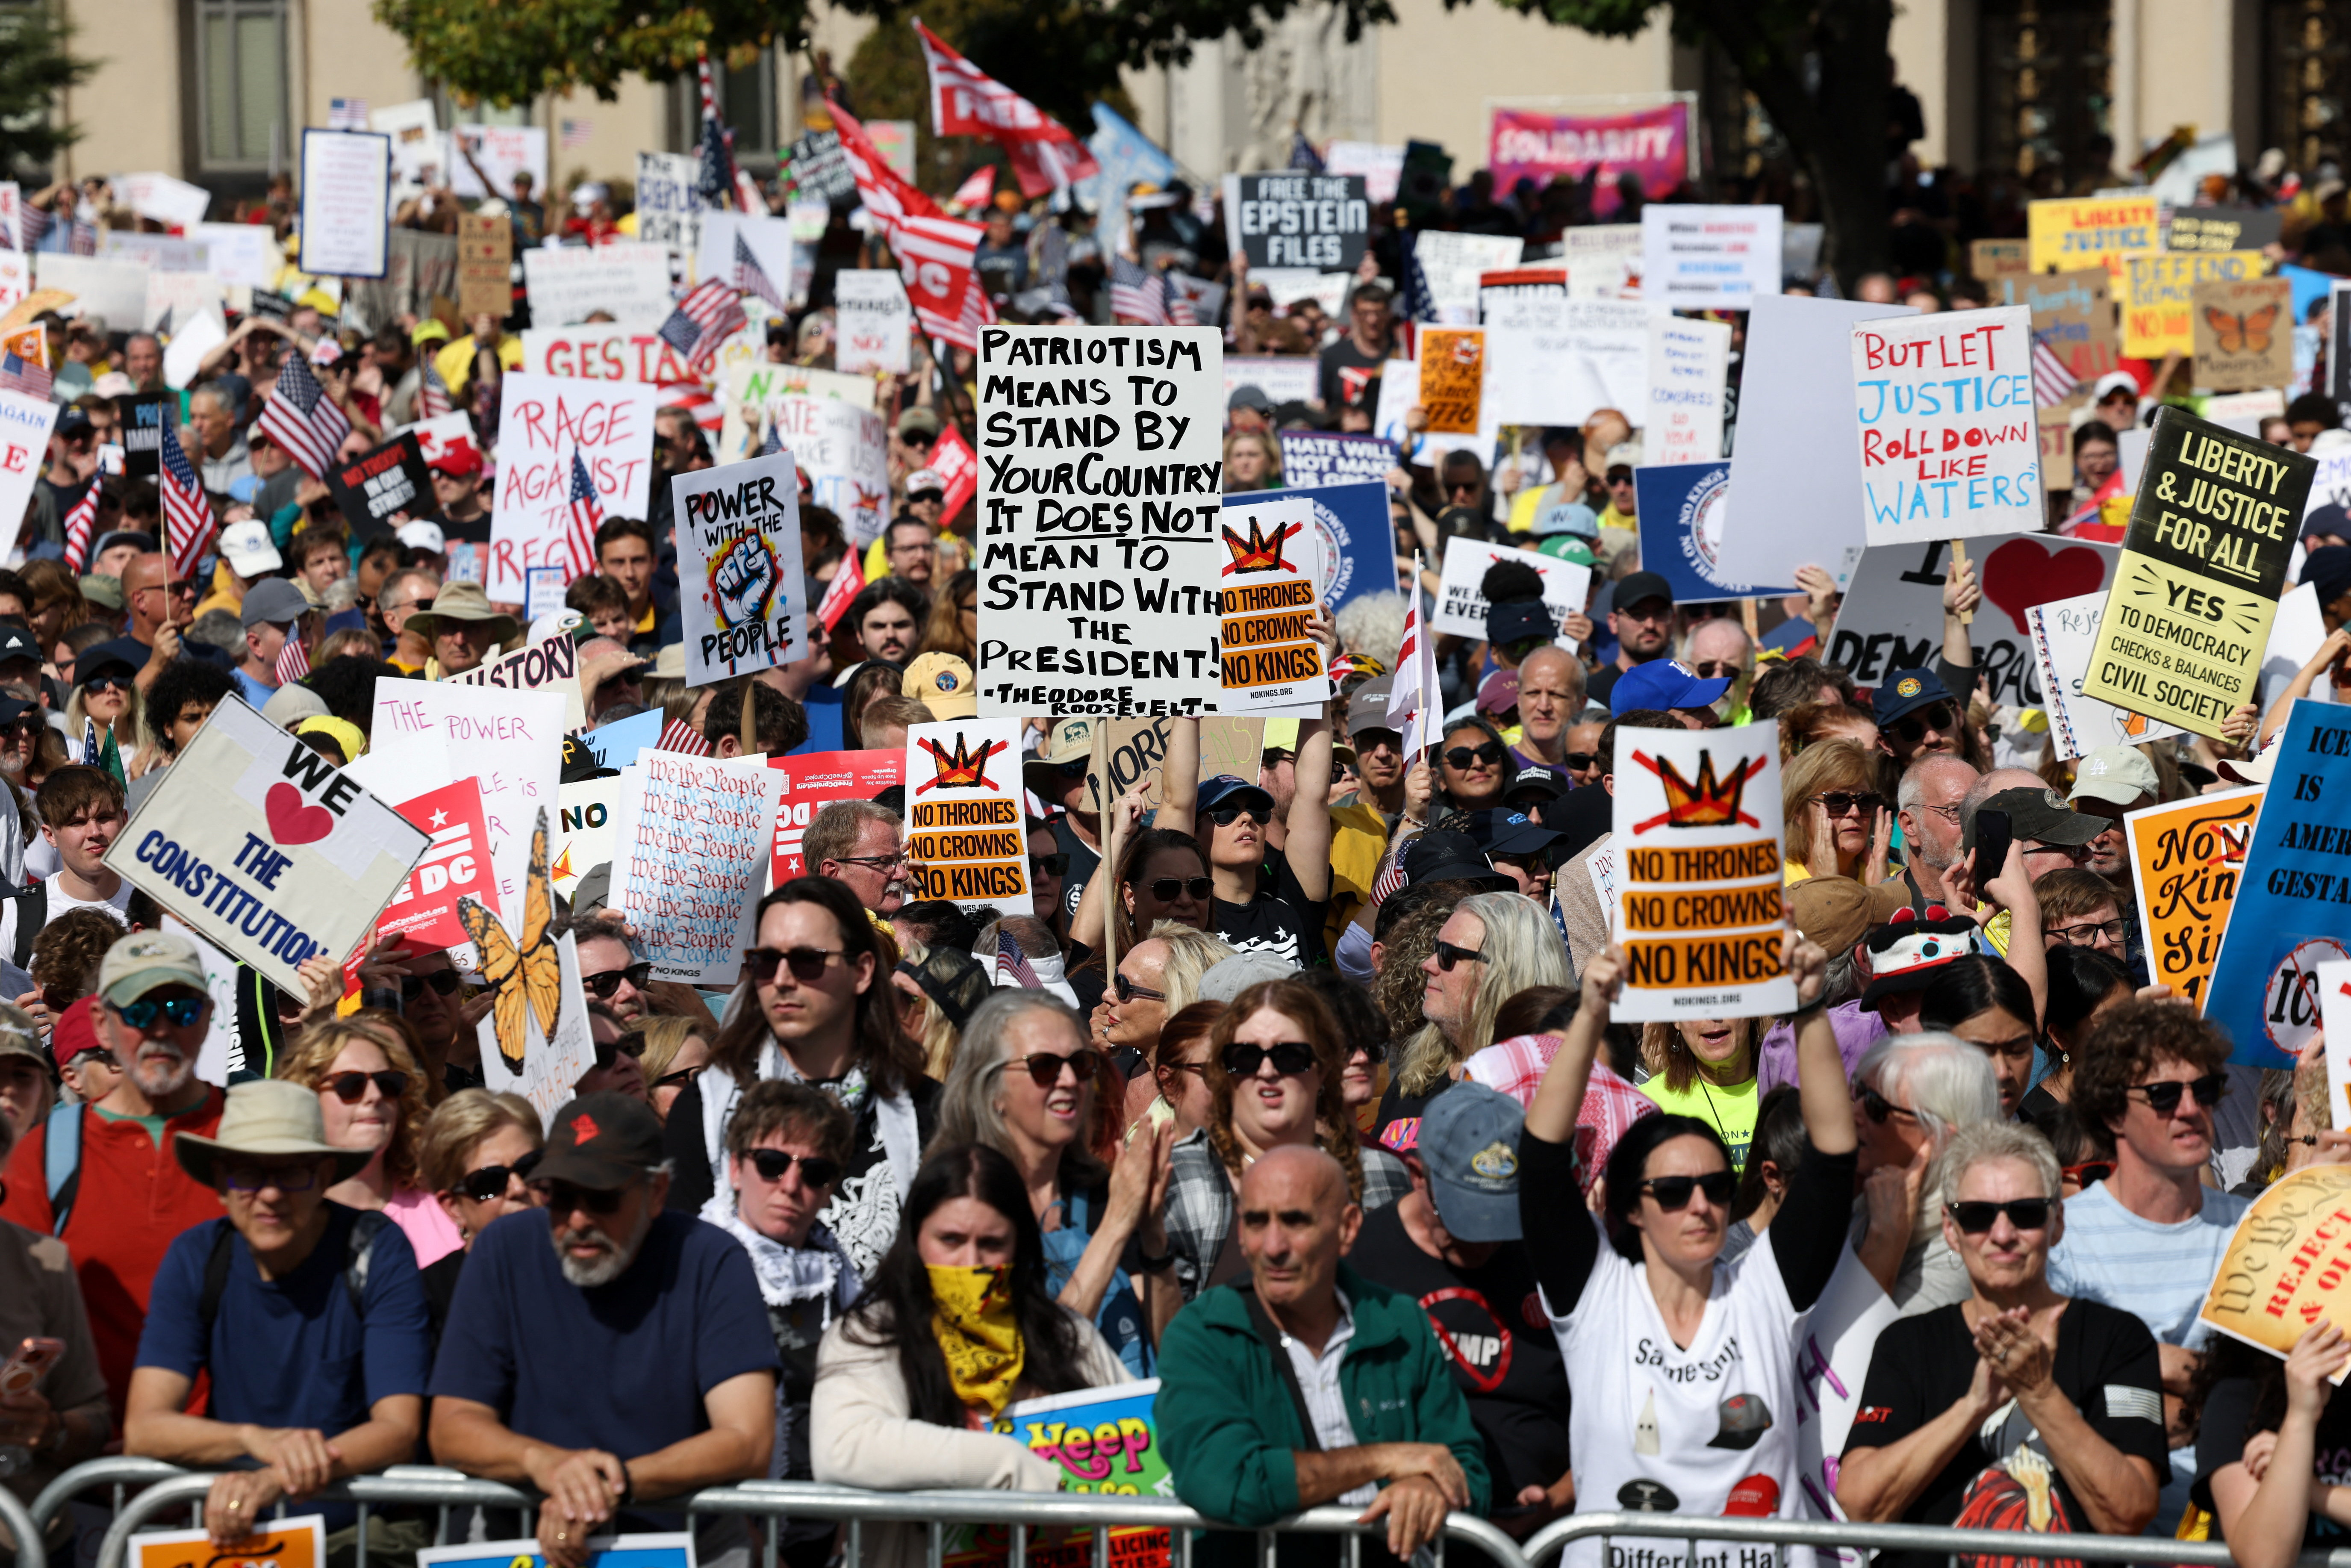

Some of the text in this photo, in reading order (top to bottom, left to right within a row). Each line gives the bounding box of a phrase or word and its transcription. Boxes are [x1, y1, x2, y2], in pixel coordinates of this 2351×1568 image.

[1495, 125, 1675, 165] SOLIDARITY
[1258, 177, 1349, 200] FREE THE
[1241, 199, 1369, 236] EPSTEIN
[2072, 205, 2154, 228] LIBERTY
[1267, 235, 1343, 266] FILES
[2061, 227, 2151, 252] JUSTICE
[982, 330, 1202, 371] PATRIOTISM
[1939, 325, 2005, 371] LET
[983, 374, 1178, 408] MEANS TO
[1858, 374, 2031, 424] JUSTICE
[513, 394, 636, 453] RAGE
[984, 410, 1191, 451] STAND BY
[1427, 401, 1475, 424] 1776
[1283, 436, 1398, 461] HATE WILL
[1864, 421, 2028, 468] ROLL DOWN
[2178, 430, 2289, 495] LIBERTY
[341, 442, 408, 489] NO TROOPS
[363, 464, 407, 500] IN OUR
[984, 454, 1075, 495] YOUR
[1076, 452, 1223, 498] COUNTRY.
[1284, 454, 1399, 477] NOT MAKE
[1285, 470, 1320, 488] US
[1918, 454, 1988, 480] LIKE
[368, 479, 417, 519] STREETS
[685, 476, 785, 529] POWER
[1678, 468, 1725, 526] NO KINGS
[2155, 471, 2290, 542] & JUSTICE
[704, 513, 783, 547] WITH THE
[986, 498, 1220, 536] IT DOES NOT
[983, 539, 1170, 572] MEAN TO
[1678, 535, 1697, 558] NO
[1900, 539, 1950, 586] I
[2154, 510, 2261, 578] FOR ALL
[983, 574, 1222, 616] STAND WITH
[1239, 581, 1313, 611] THRONES
[1449, 584, 1470, 598] WE
[2166, 579, 2227, 622] YES
[563, 617, 583, 629] G
[701, 615, 794, 668] PEOPLE
[1067, 616, 1133, 645] THE
[1244, 613, 1314, 643] CROWNS
[2121, 604, 2252, 667] TO DEMOCRACY
[981, 636, 1220, 679] PRESIDENT!
[1221, 647, 1319, 687] NO KINGS
[1668, 661, 1692, 678] LA
[2111, 636, 2242, 693] CHECKS & BALANCES
[1249, 687, 1293, 700] NOKINGS.ORG
[2101, 662, 2237, 722] CIVIL SOCIETY
[377, 700, 534, 741] THE POWER
[1065, 734, 1091, 744] MICATO
[2307, 725, 2351, 757] ICE
[282, 741, 362, 817] WE
[518, 777, 538, 797] is
[649, 757, 769, 799] We the People
[796, 780, 853, 790] FreeDCproject.org
[804, 771, 853, 781] @FreeDCproject
[2293, 774, 2324, 802] IS
[560, 802, 608, 834] NO
[643, 790, 762, 830] We the People
[776, 802, 810, 828] DC
[913, 800, 1017, 828] NO THRONES
[637, 823, 755, 862] We the People
[911, 832, 1019, 860] NO CROWNS
[2152, 803, 2256, 873] No
[233, 831, 294, 891] THE
[419, 855, 477, 896] DC
[631, 856, 748, 893] We the People
[1629, 841, 1779, 881] NO THRONES
[136, 829, 330, 972] CONSTITUTION
[913, 866, 1022, 899] NO KINGS
[625, 889, 742, 924] We the People
[1630, 888, 1782, 928] NO CROWNS
[651, 924, 736, 955] the People
[655, 966, 701, 977] NO KINGS
[1628, 937, 1784, 984] NO KINGS
[1673, 992, 1742, 1007] NOKINGS.ORG
[2213, 1200, 2310, 1317] We the
[2299, 1300, 2324, 1326] &
[1635, 1338, 1697, 1383] Same
[1025, 1416, 1150, 1480] Keep
